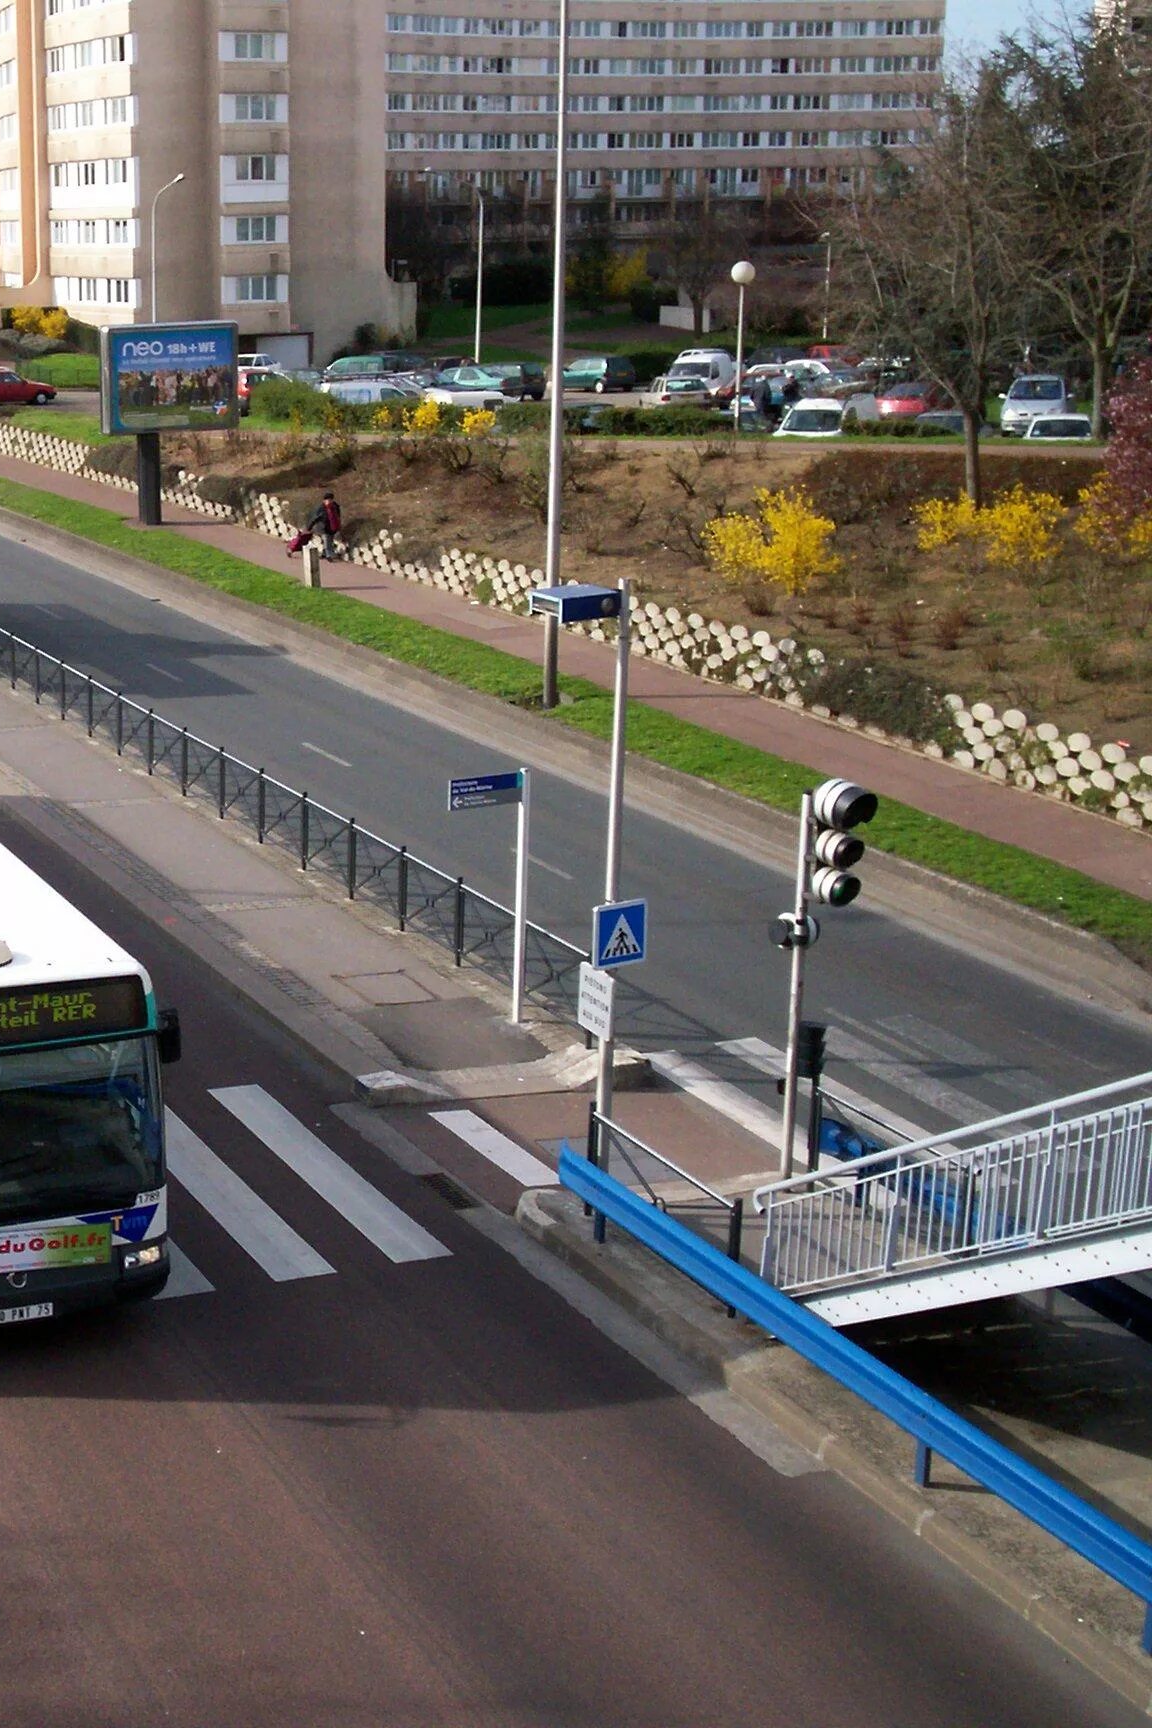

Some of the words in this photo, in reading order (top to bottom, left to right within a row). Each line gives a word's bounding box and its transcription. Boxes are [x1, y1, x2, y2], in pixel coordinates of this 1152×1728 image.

[122, 340, 164, 357] neo
[52, 1002, 97, 1023] RER
[37, 1304, 50, 1316] 75
